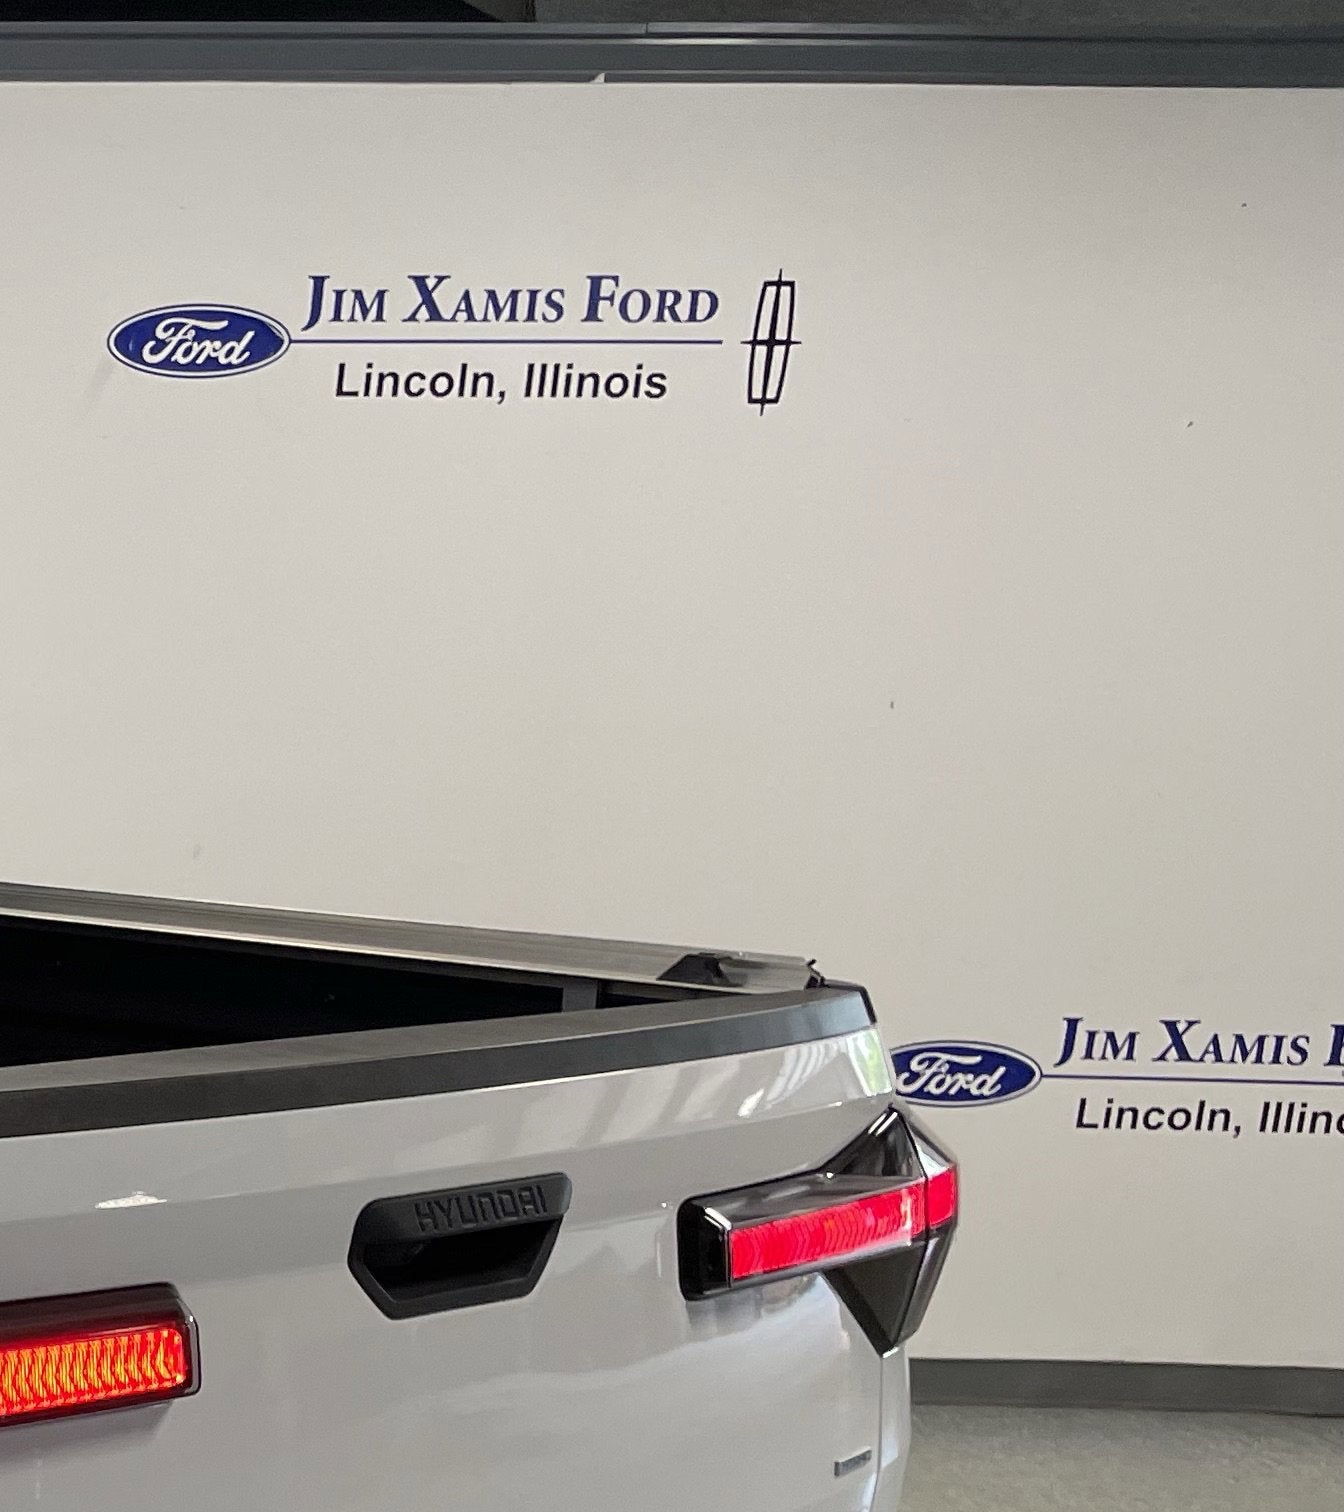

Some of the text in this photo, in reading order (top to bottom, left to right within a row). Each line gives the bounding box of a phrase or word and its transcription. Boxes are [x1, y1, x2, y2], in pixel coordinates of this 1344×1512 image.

[141, 318, 251, 366] Ford
[335, 362, 667, 405] Lincoln, Illinois
[897, 1051, 1007, 1097] Ford
[1075, 1097, 1241, 1139] Lincoln,
[414, 1184, 548, 1232] HYUNDAI
